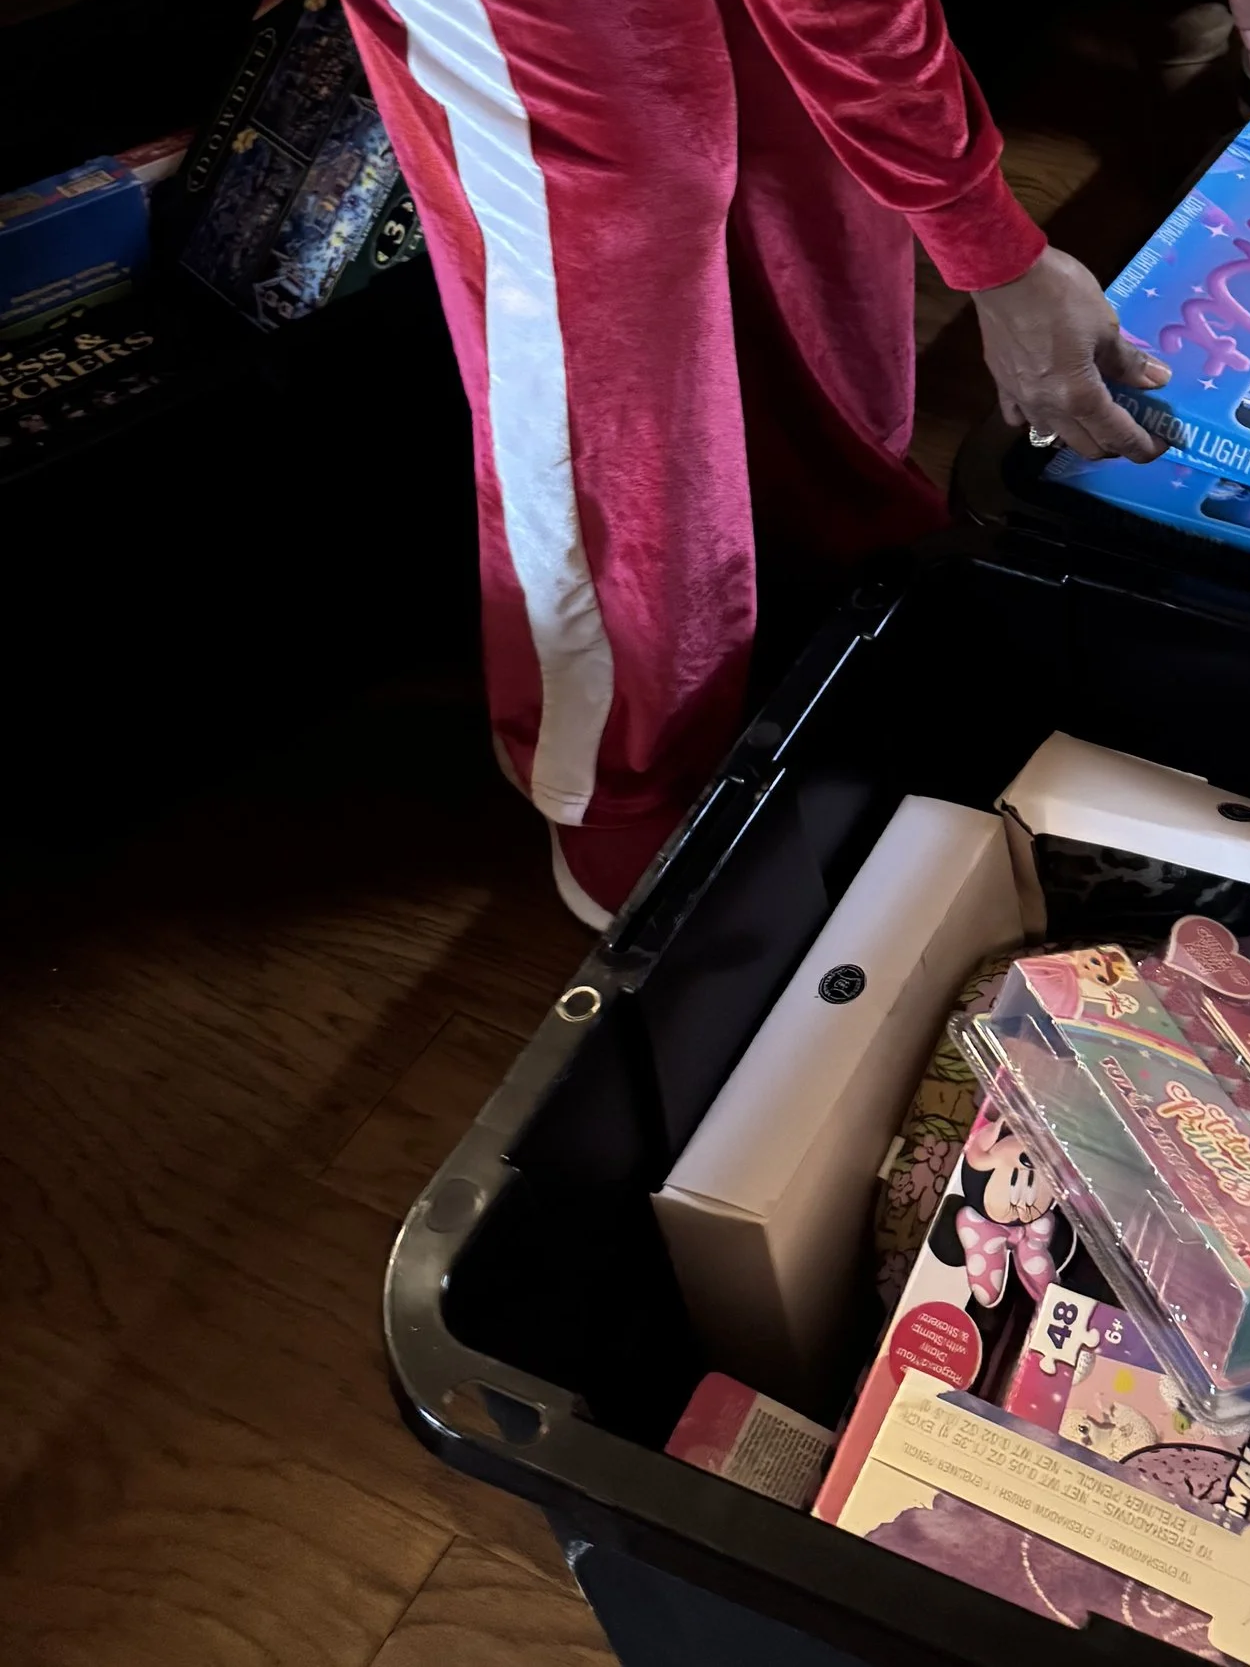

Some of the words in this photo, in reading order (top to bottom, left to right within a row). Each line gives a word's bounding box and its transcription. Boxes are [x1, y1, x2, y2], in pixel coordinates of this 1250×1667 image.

[74, 331, 110, 352] &
[1142, 407, 1199, 448] NEON
[1047, 1301, 1078, 1349] 48
[1105, 1318, 1124, 1344] 6+
[1034, 1453, 1062, 1475] NET
[1060, 1481, 1091, 1506] NET
[1077, 1472, 1121, 1498] PENCIL
[1125, 1494, 1188, 1531] EYELINER
[1103, 1501, 1195, 1552] EYESHADOWS
